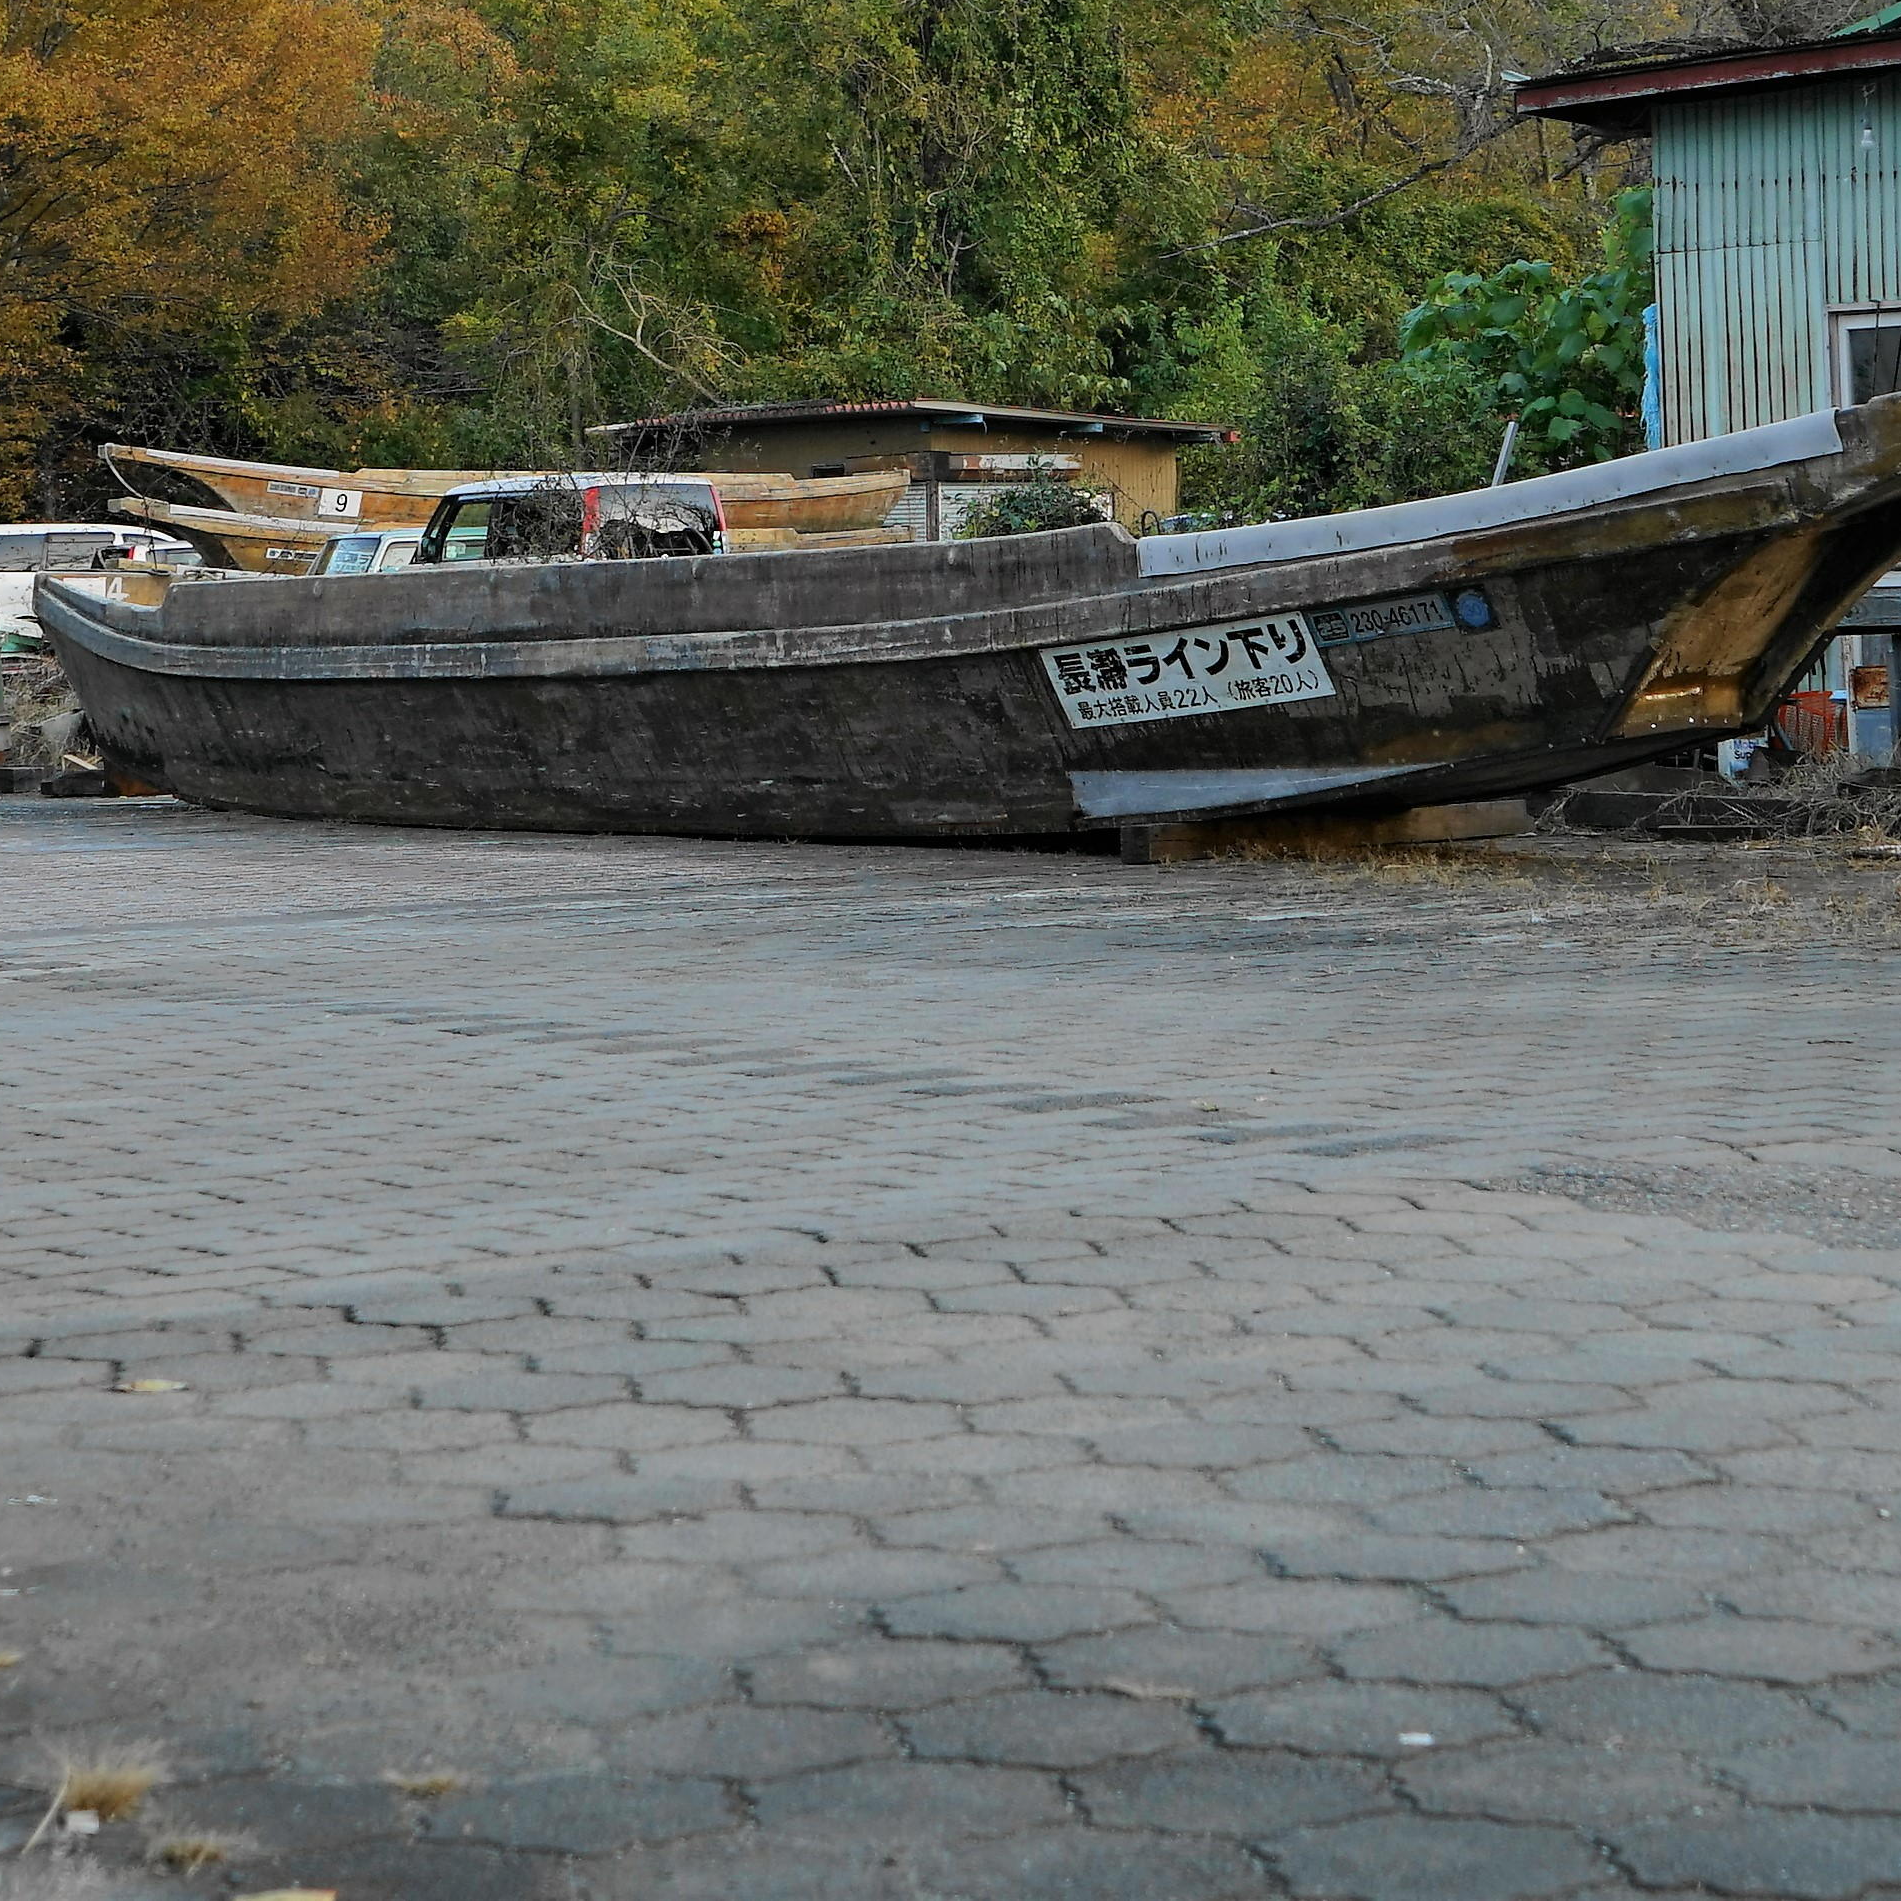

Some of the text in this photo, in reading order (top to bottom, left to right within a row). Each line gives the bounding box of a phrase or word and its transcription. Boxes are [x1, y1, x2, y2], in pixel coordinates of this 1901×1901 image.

[335, 494, 348, 512] 9
[1053, 619, 1308, 696] 長瀞ライン下り
